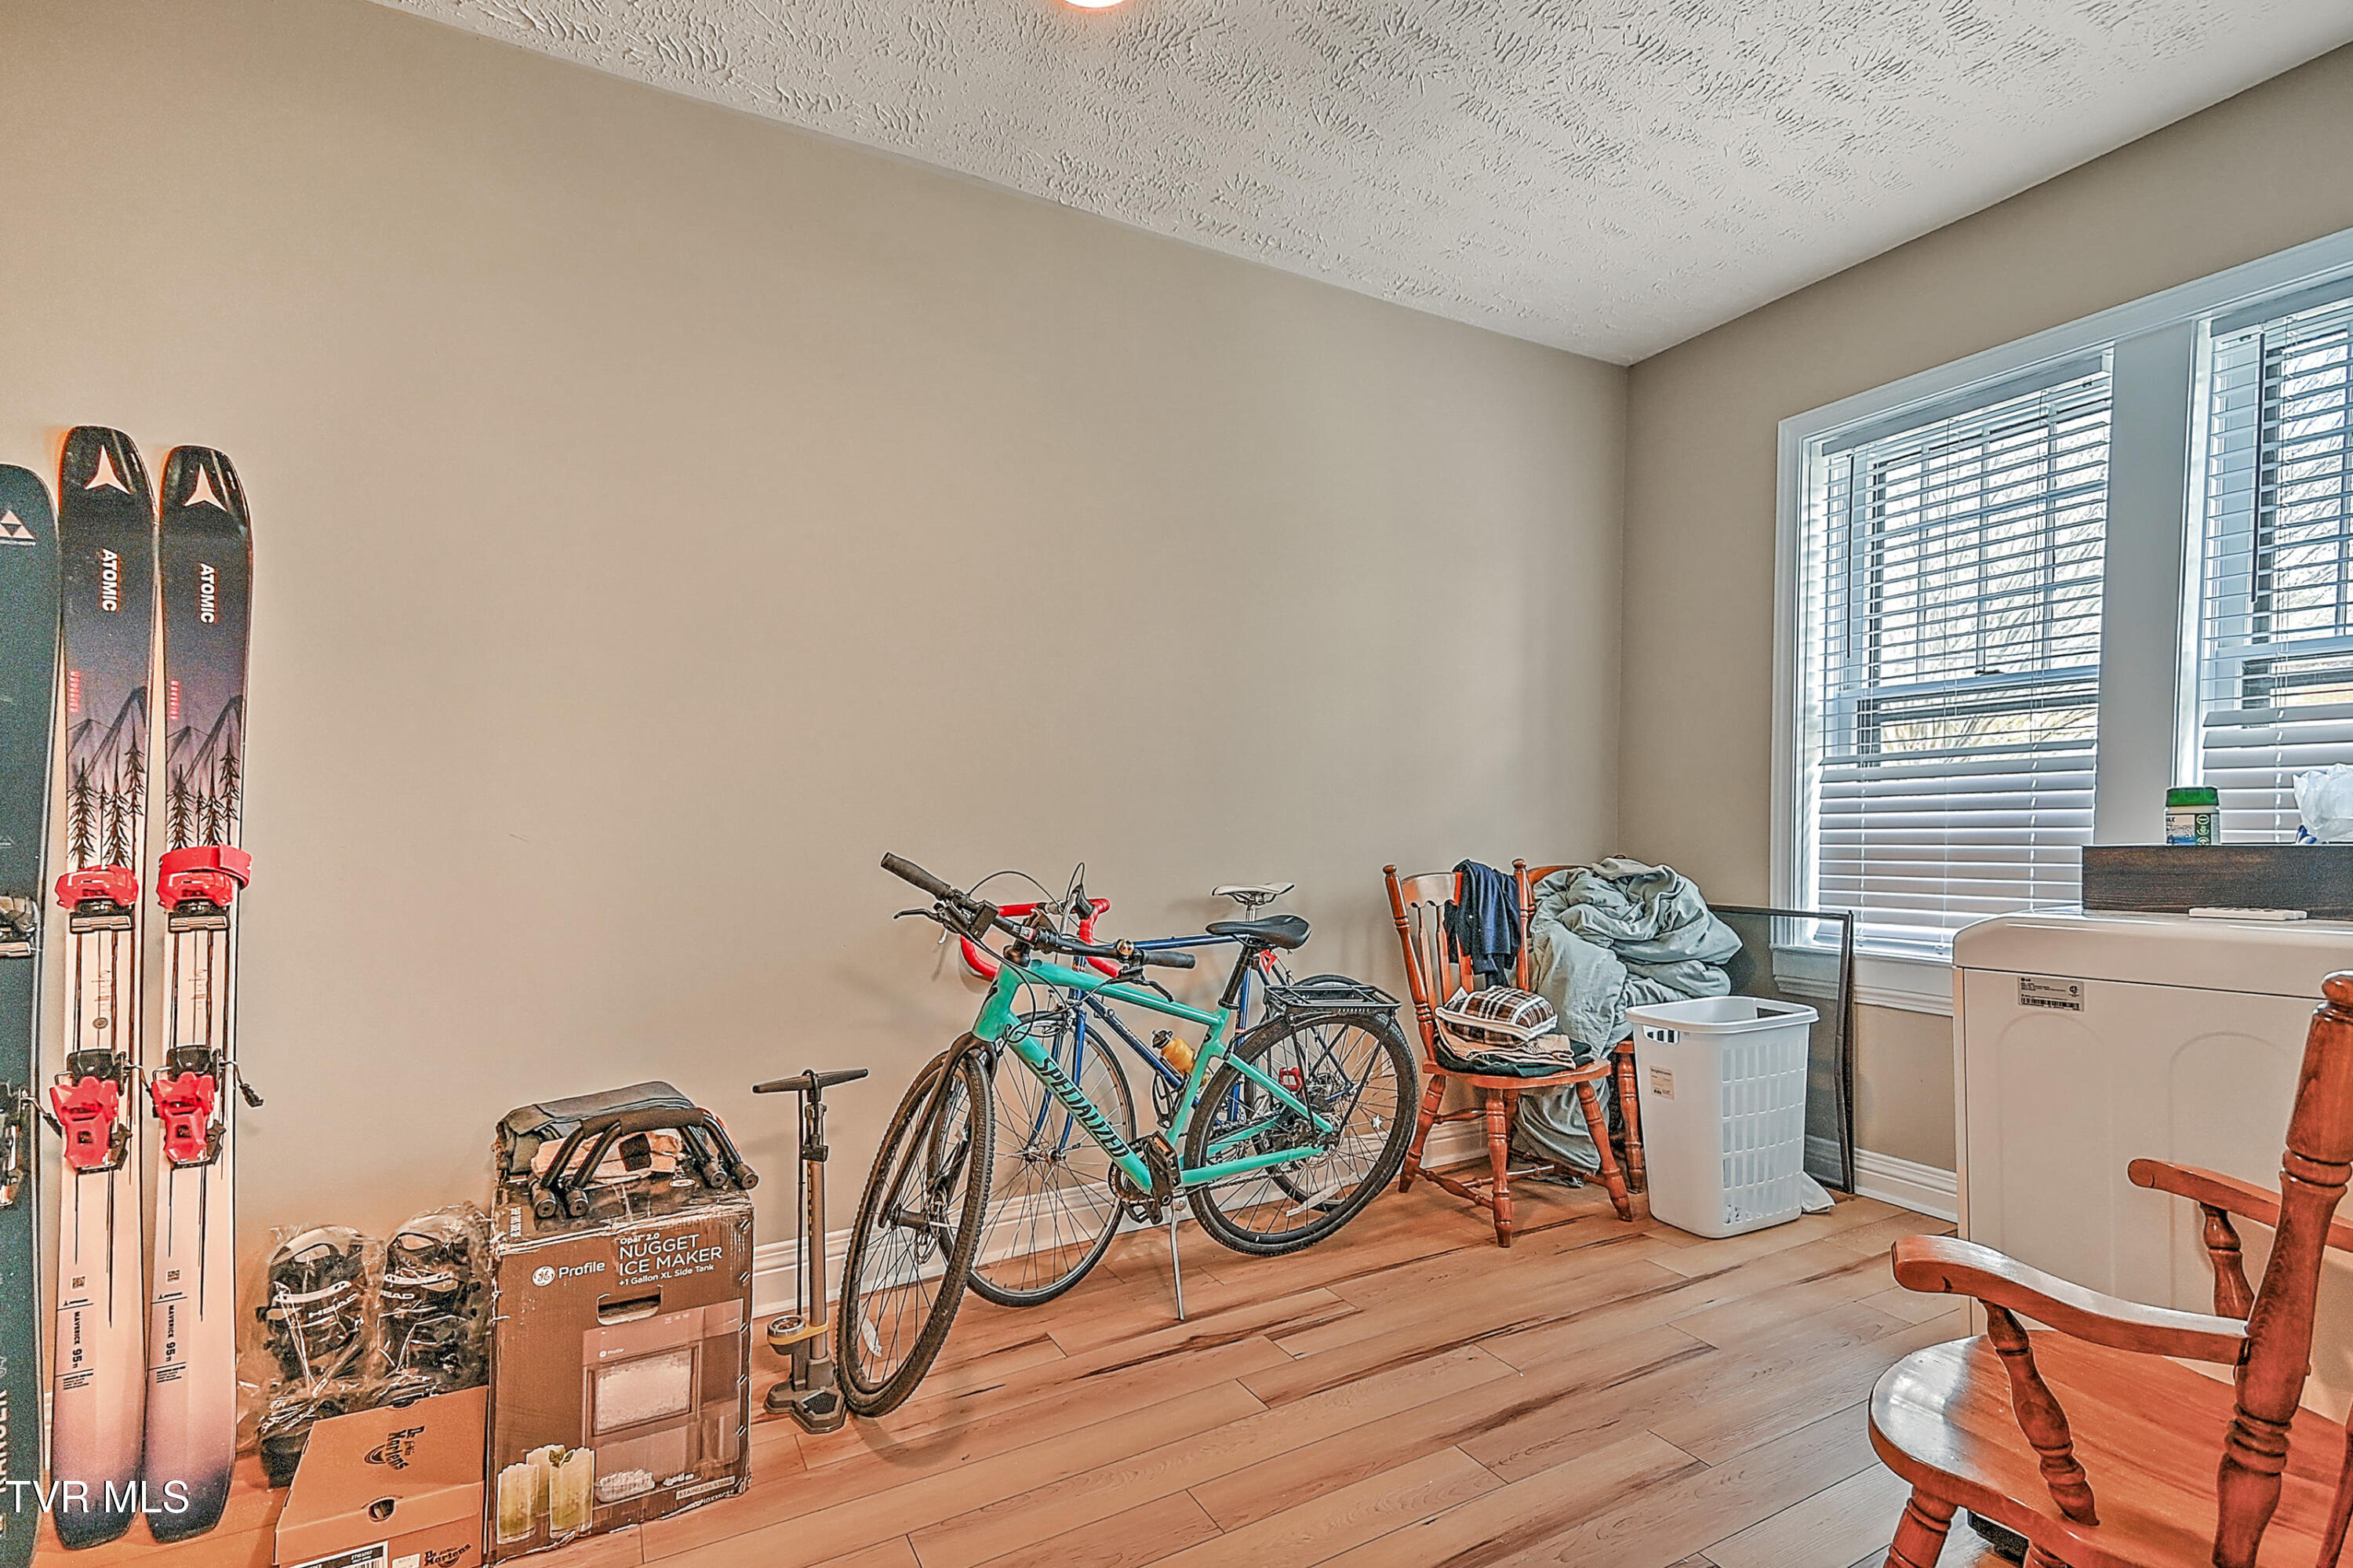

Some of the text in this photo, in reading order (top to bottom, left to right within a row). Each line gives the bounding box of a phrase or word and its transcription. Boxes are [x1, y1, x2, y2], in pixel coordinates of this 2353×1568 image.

[103, 548, 118, 612] ATOMIC
[200, 562, 215, 624] ATOMIC
[1031, 1057, 1129, 1157] SPECIALIZED
[619, 1246, 722, 1276] ICE MAKER
[620, 1234, 700, 1260] NUGGET
[558, 1261, 606, 1279] Profile
[631, 1274, 659, 1285] Gallon
[675, 1268, 693, 1277] Side
[695, 1264, 715, 1272] Tank
